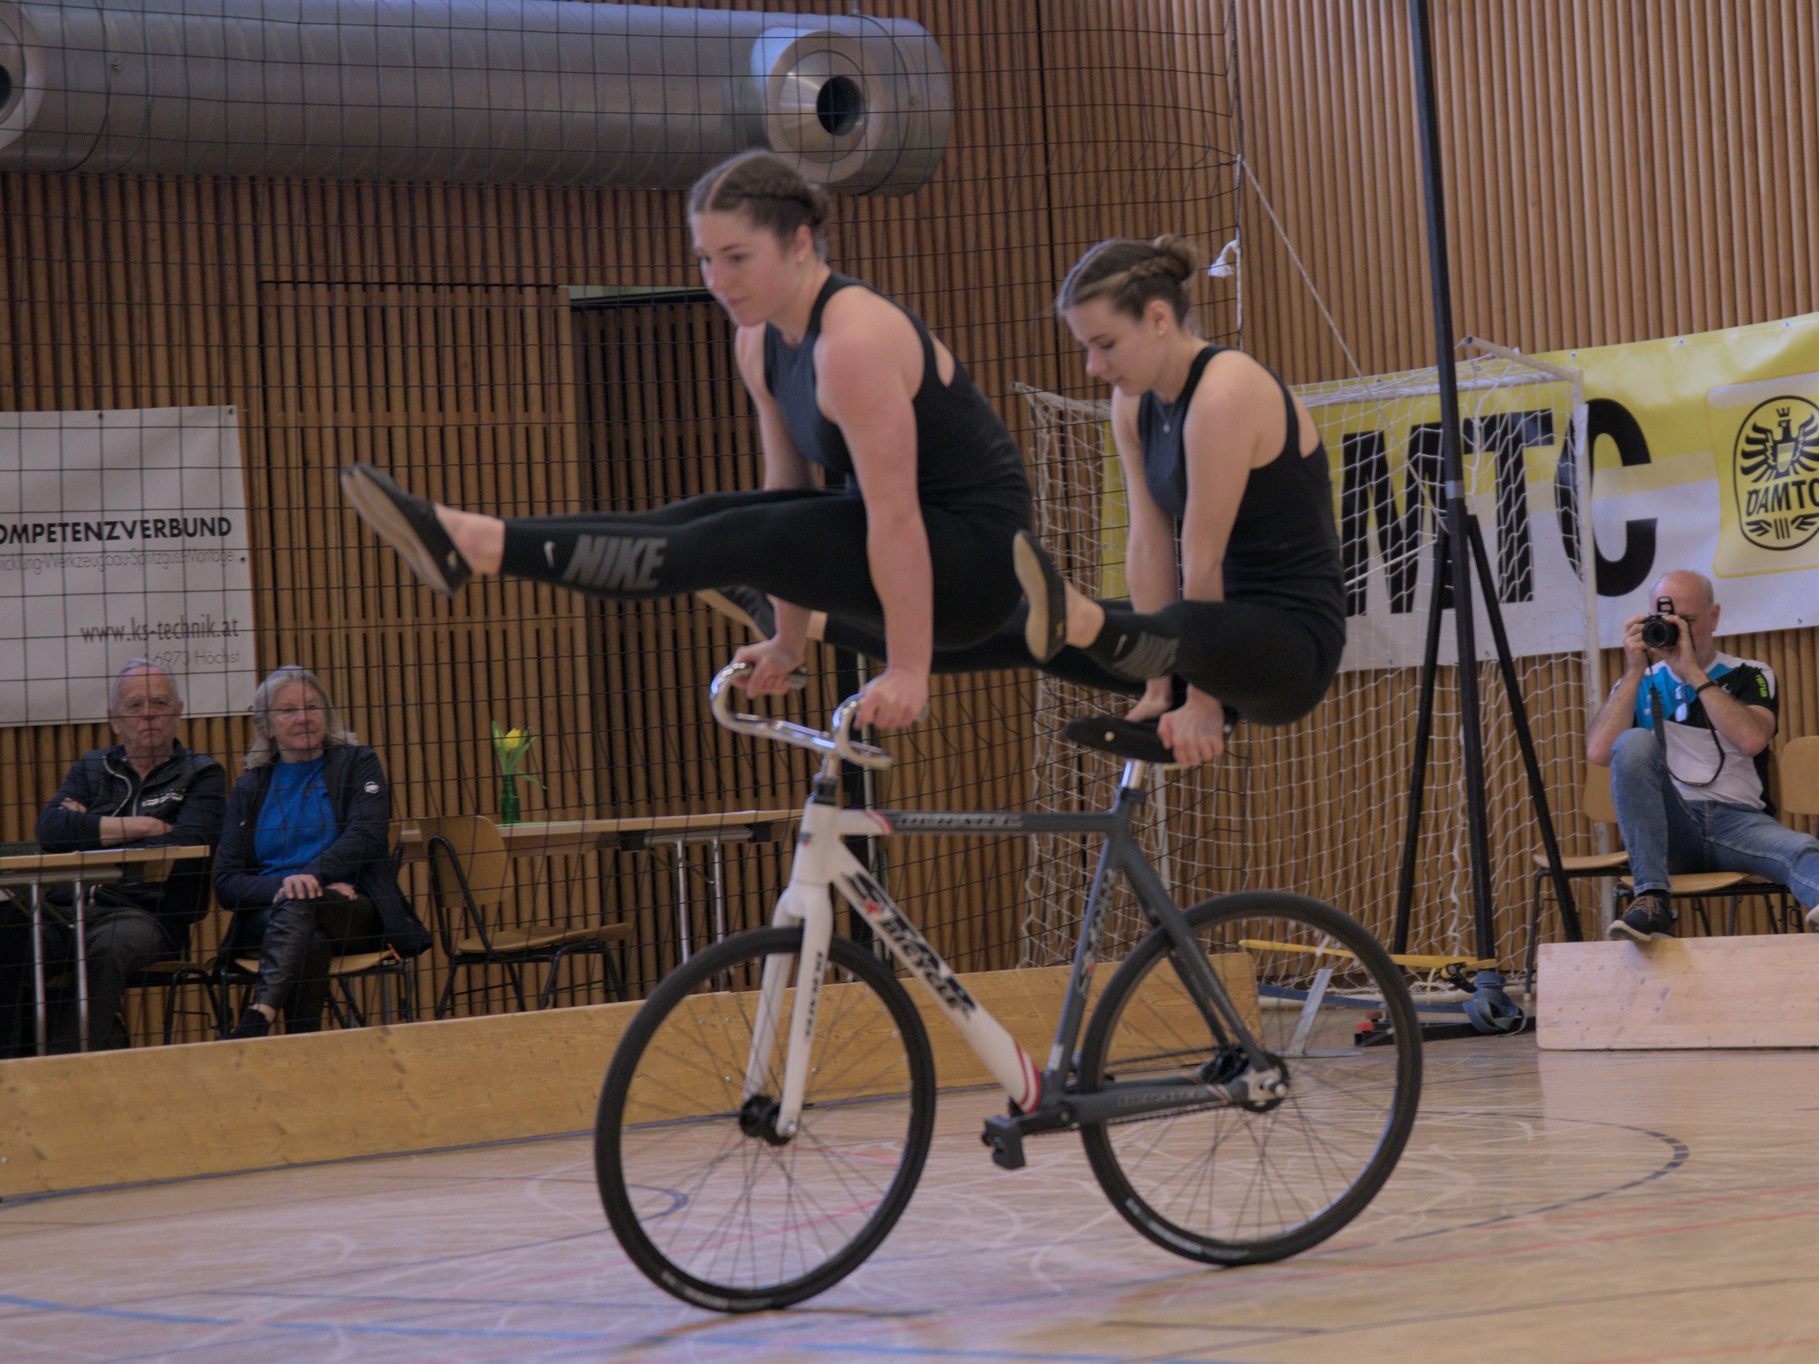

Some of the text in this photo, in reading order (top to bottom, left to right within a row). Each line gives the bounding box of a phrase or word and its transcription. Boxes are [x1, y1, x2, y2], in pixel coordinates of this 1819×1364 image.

[1343, 398, 1657, 616] MTC
[562, 533, 668, 592] NIKE
[80, 613, 239, 643] www.ks-technik.at
